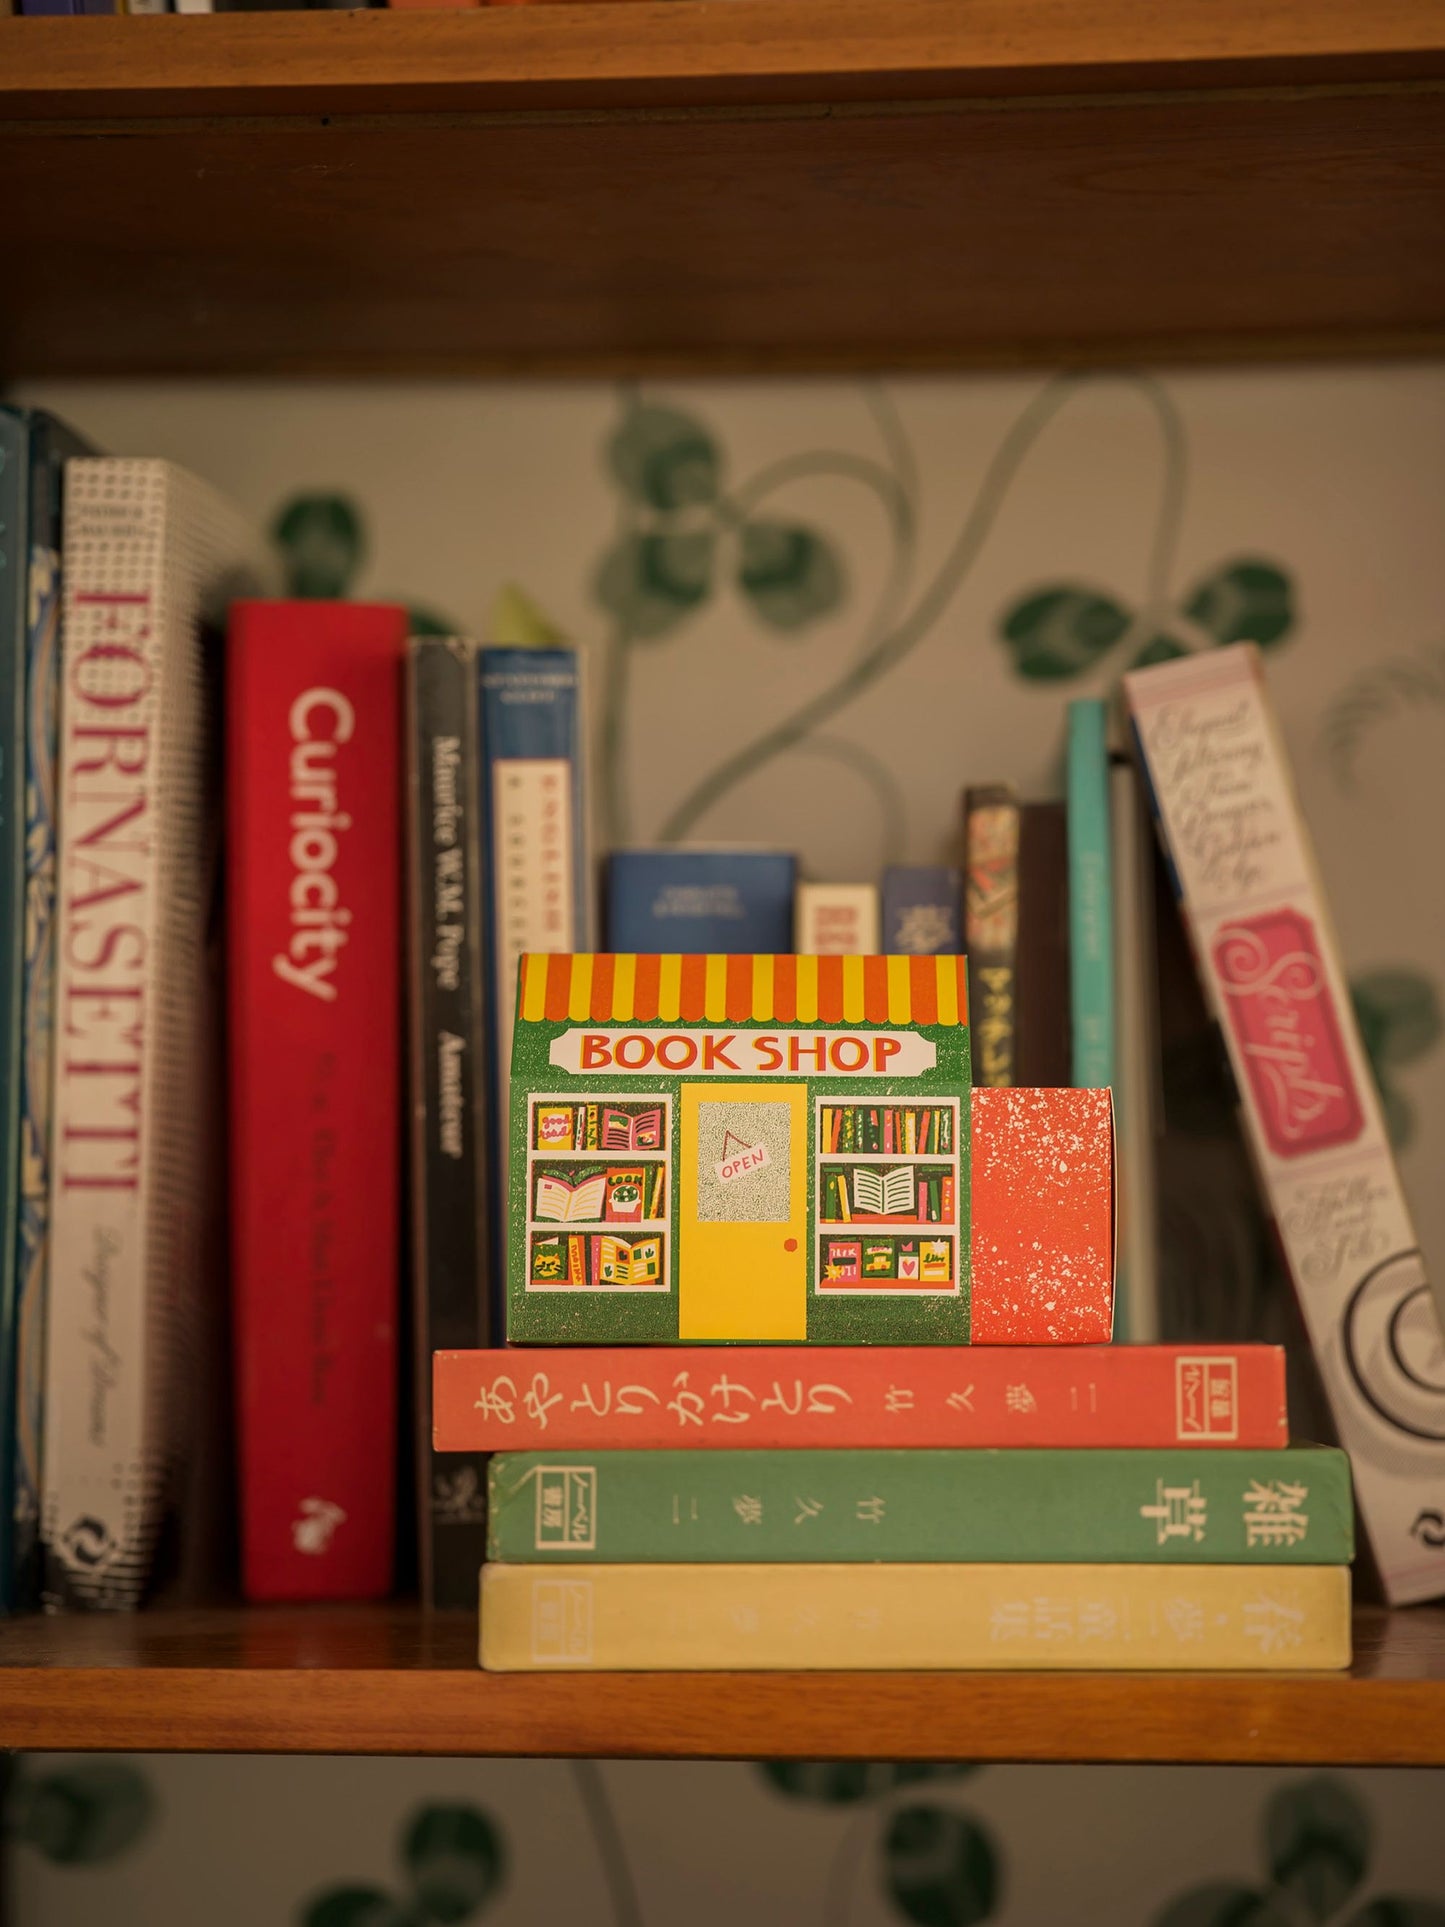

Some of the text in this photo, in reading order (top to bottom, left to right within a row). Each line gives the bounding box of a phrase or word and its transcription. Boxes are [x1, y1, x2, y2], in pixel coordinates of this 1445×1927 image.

[432, 735, 462, 848] Maurice
[272, 687, 355, 1001] Curiocity
[62, 588, 153, 1192] FORNASETTI
[431, 924, 464, 991] Pope
[579, 1033, 902, 1073] BOOK SHOP
[437, 1029, 467, 1160] Amateur
[542, 1113, 571, 1129] good
[722, 1149, 764, 1178] OPEN
[474, 1371, 853, 1430] あやとりかけとり
[1183, 1364, 1202, 1432] ノーベル
[1210, 1378, 1232, 1419] 書房
[543, 1485, 563, 1529] 書房
[571, 1470, 592, 1542] ノーベル
